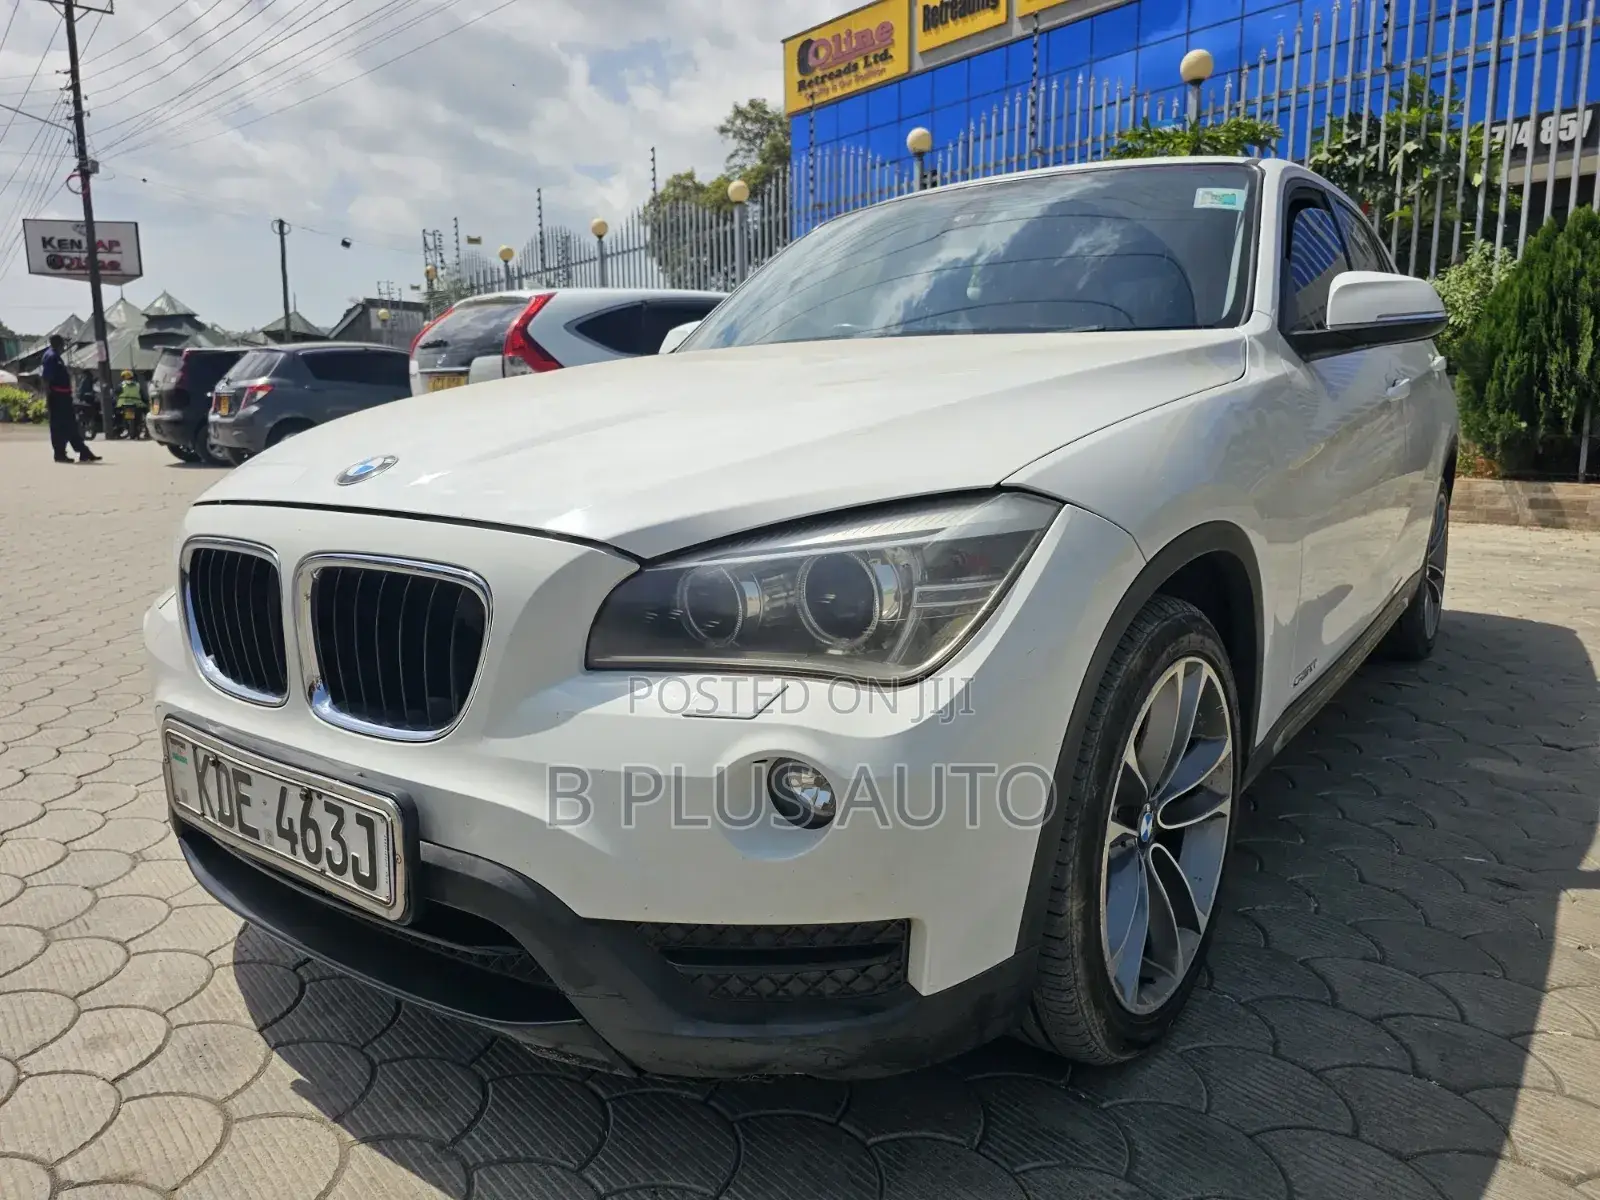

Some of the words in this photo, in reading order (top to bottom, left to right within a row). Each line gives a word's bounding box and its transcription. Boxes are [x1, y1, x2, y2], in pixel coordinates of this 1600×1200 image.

[797, 61, 860, 93] Retreads
[863, 48, 894, 70] Ltd.
[192, 744, 260, 841] KDE
[276, 785, 379, 892] 463J
